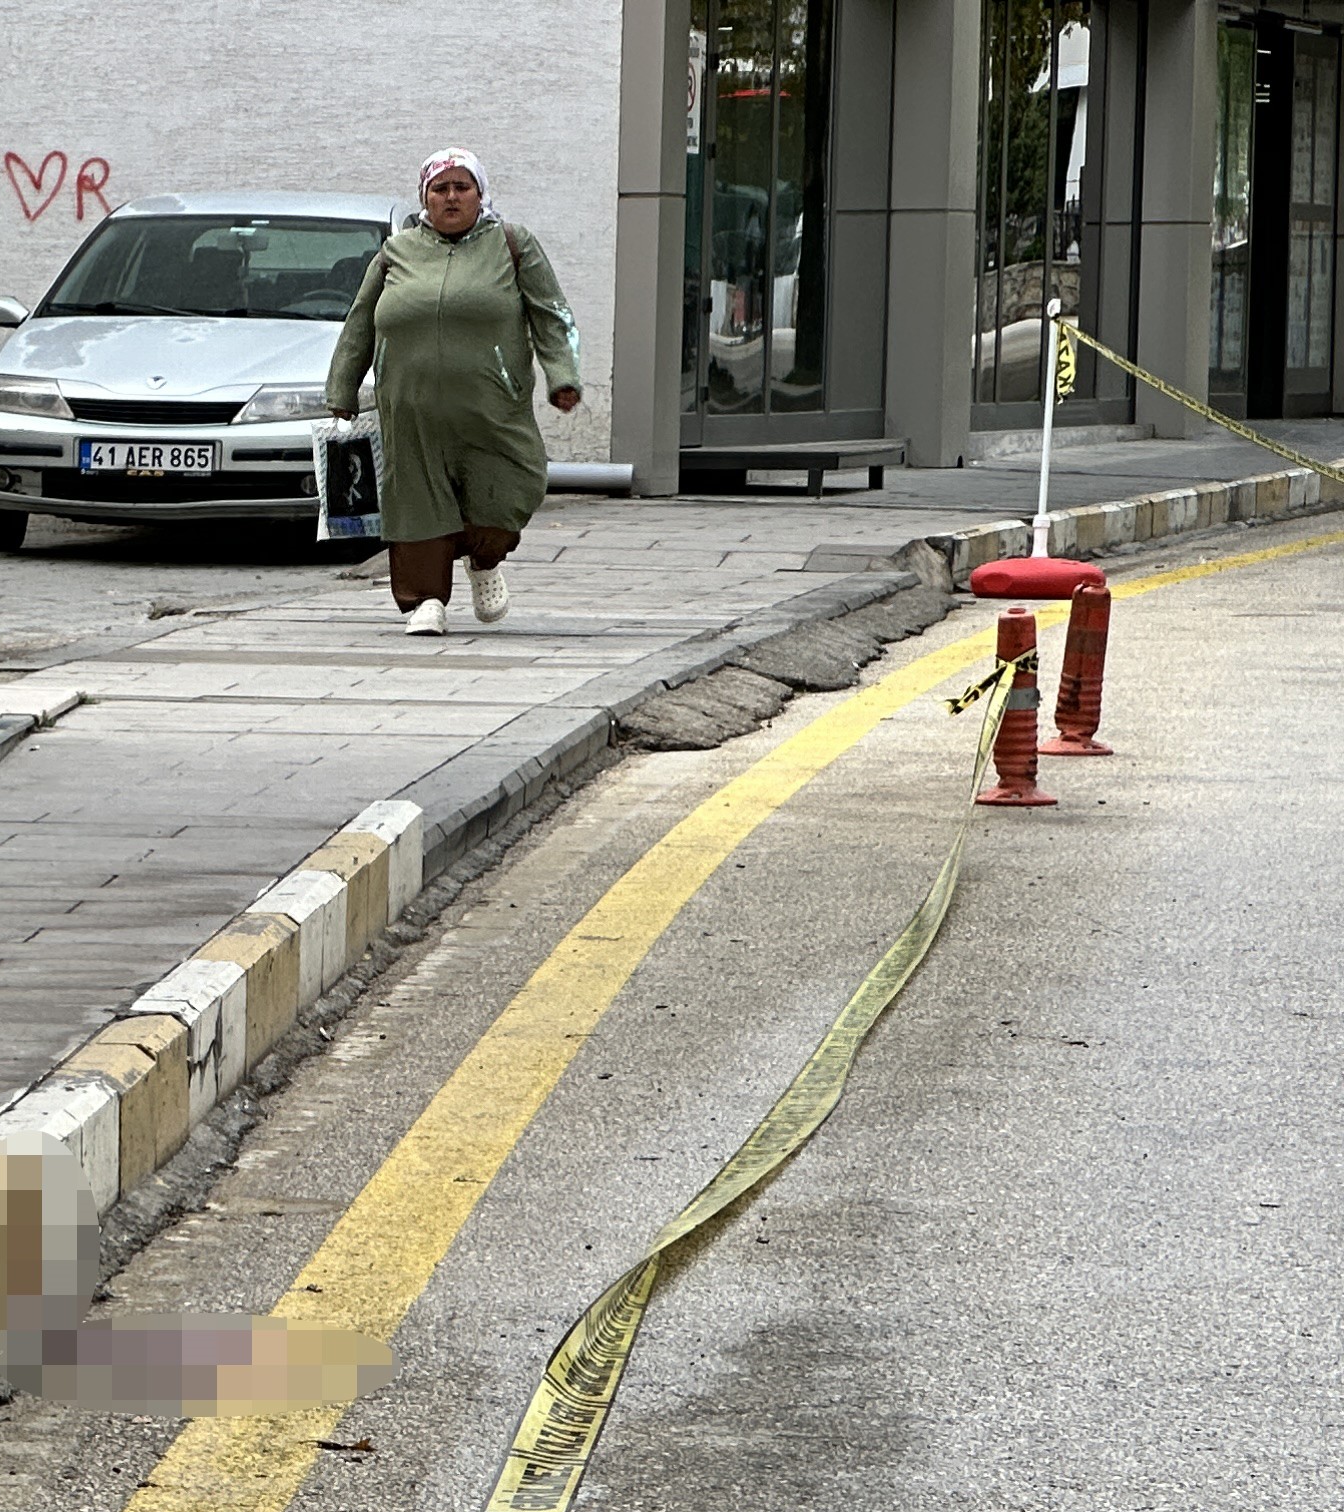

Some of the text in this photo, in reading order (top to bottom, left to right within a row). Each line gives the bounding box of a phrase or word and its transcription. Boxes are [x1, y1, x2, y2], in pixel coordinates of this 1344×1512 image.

[93, 446, 210, 468] 41 AER 865
